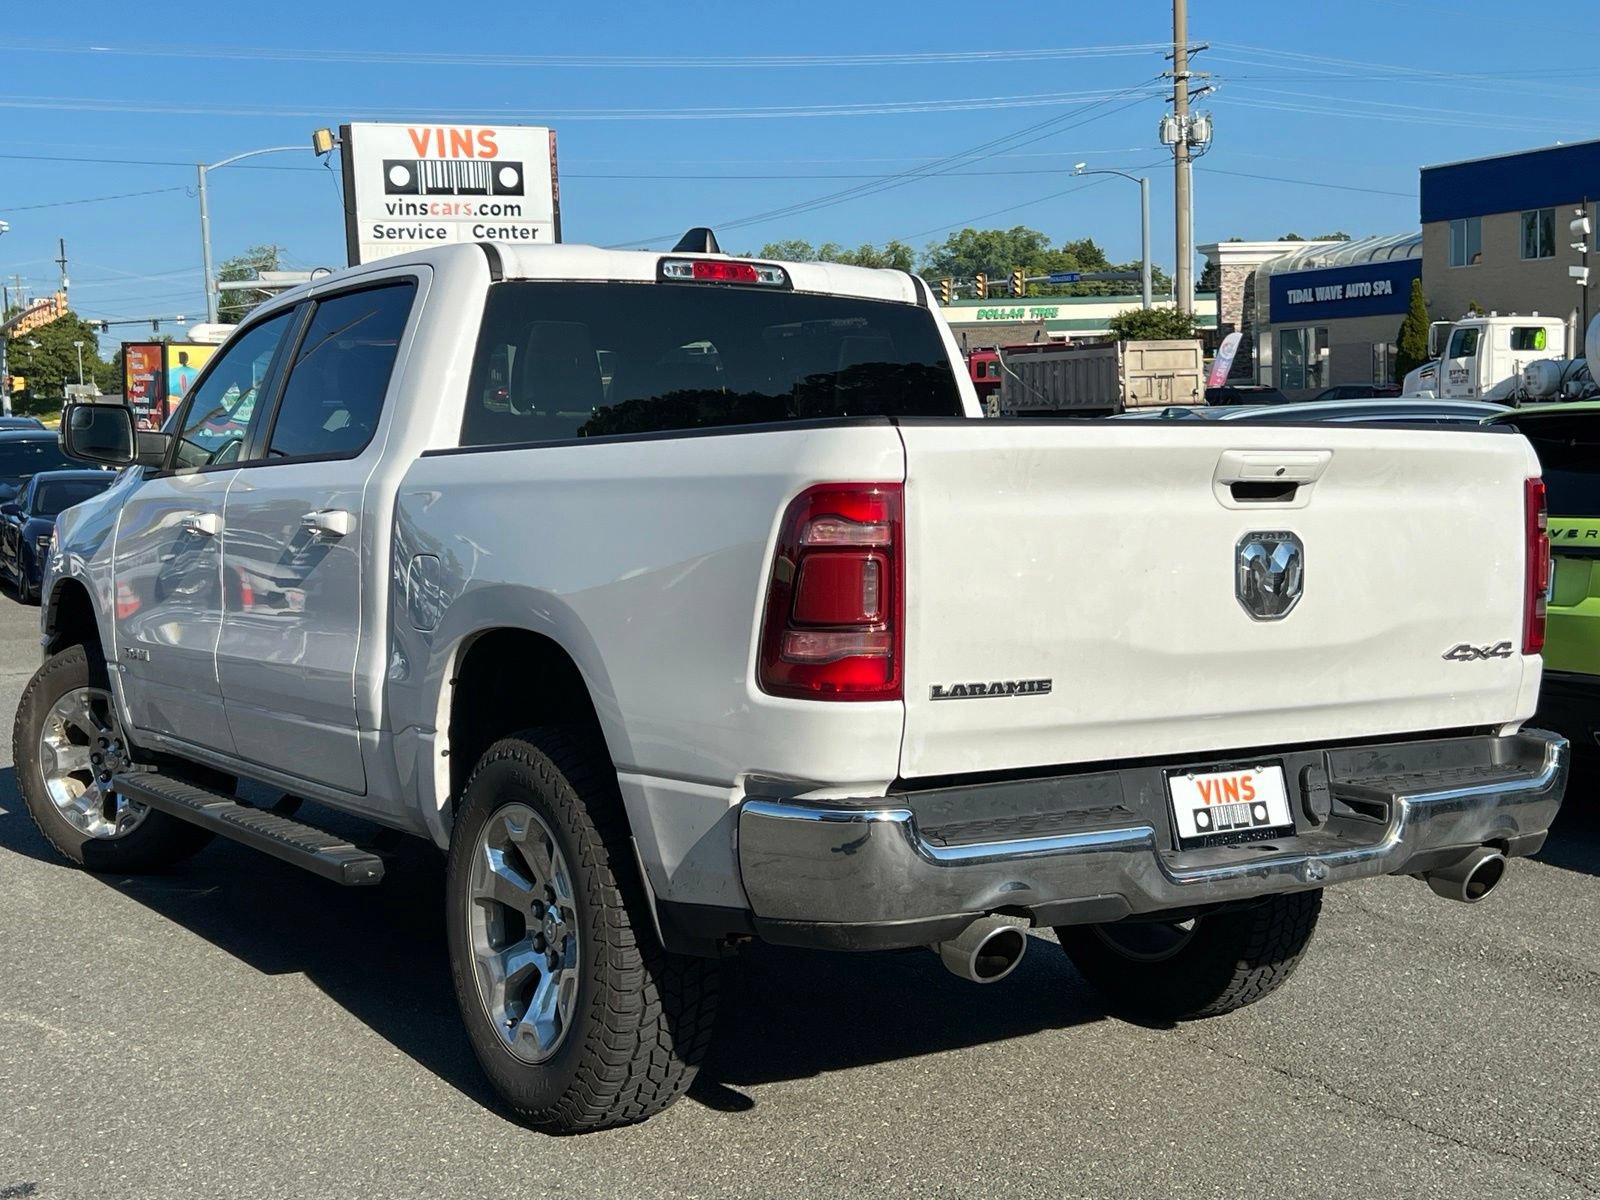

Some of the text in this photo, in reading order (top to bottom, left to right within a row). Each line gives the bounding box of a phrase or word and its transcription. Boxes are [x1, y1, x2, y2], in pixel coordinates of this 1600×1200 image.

[407, 128, 499, 159] VINS
[385, 198, 522, 217] vinscars.com
[372, 224, 539, 240] Service Center
[1287, 280, 1392, 304] TIDAL WAVE AUTO SPA
[976, 307, 1059, 320] DOLLAR TREE
[929, 679, 1052, 701] LARAMIE
[1196, 775, 1257, 805] VINS
